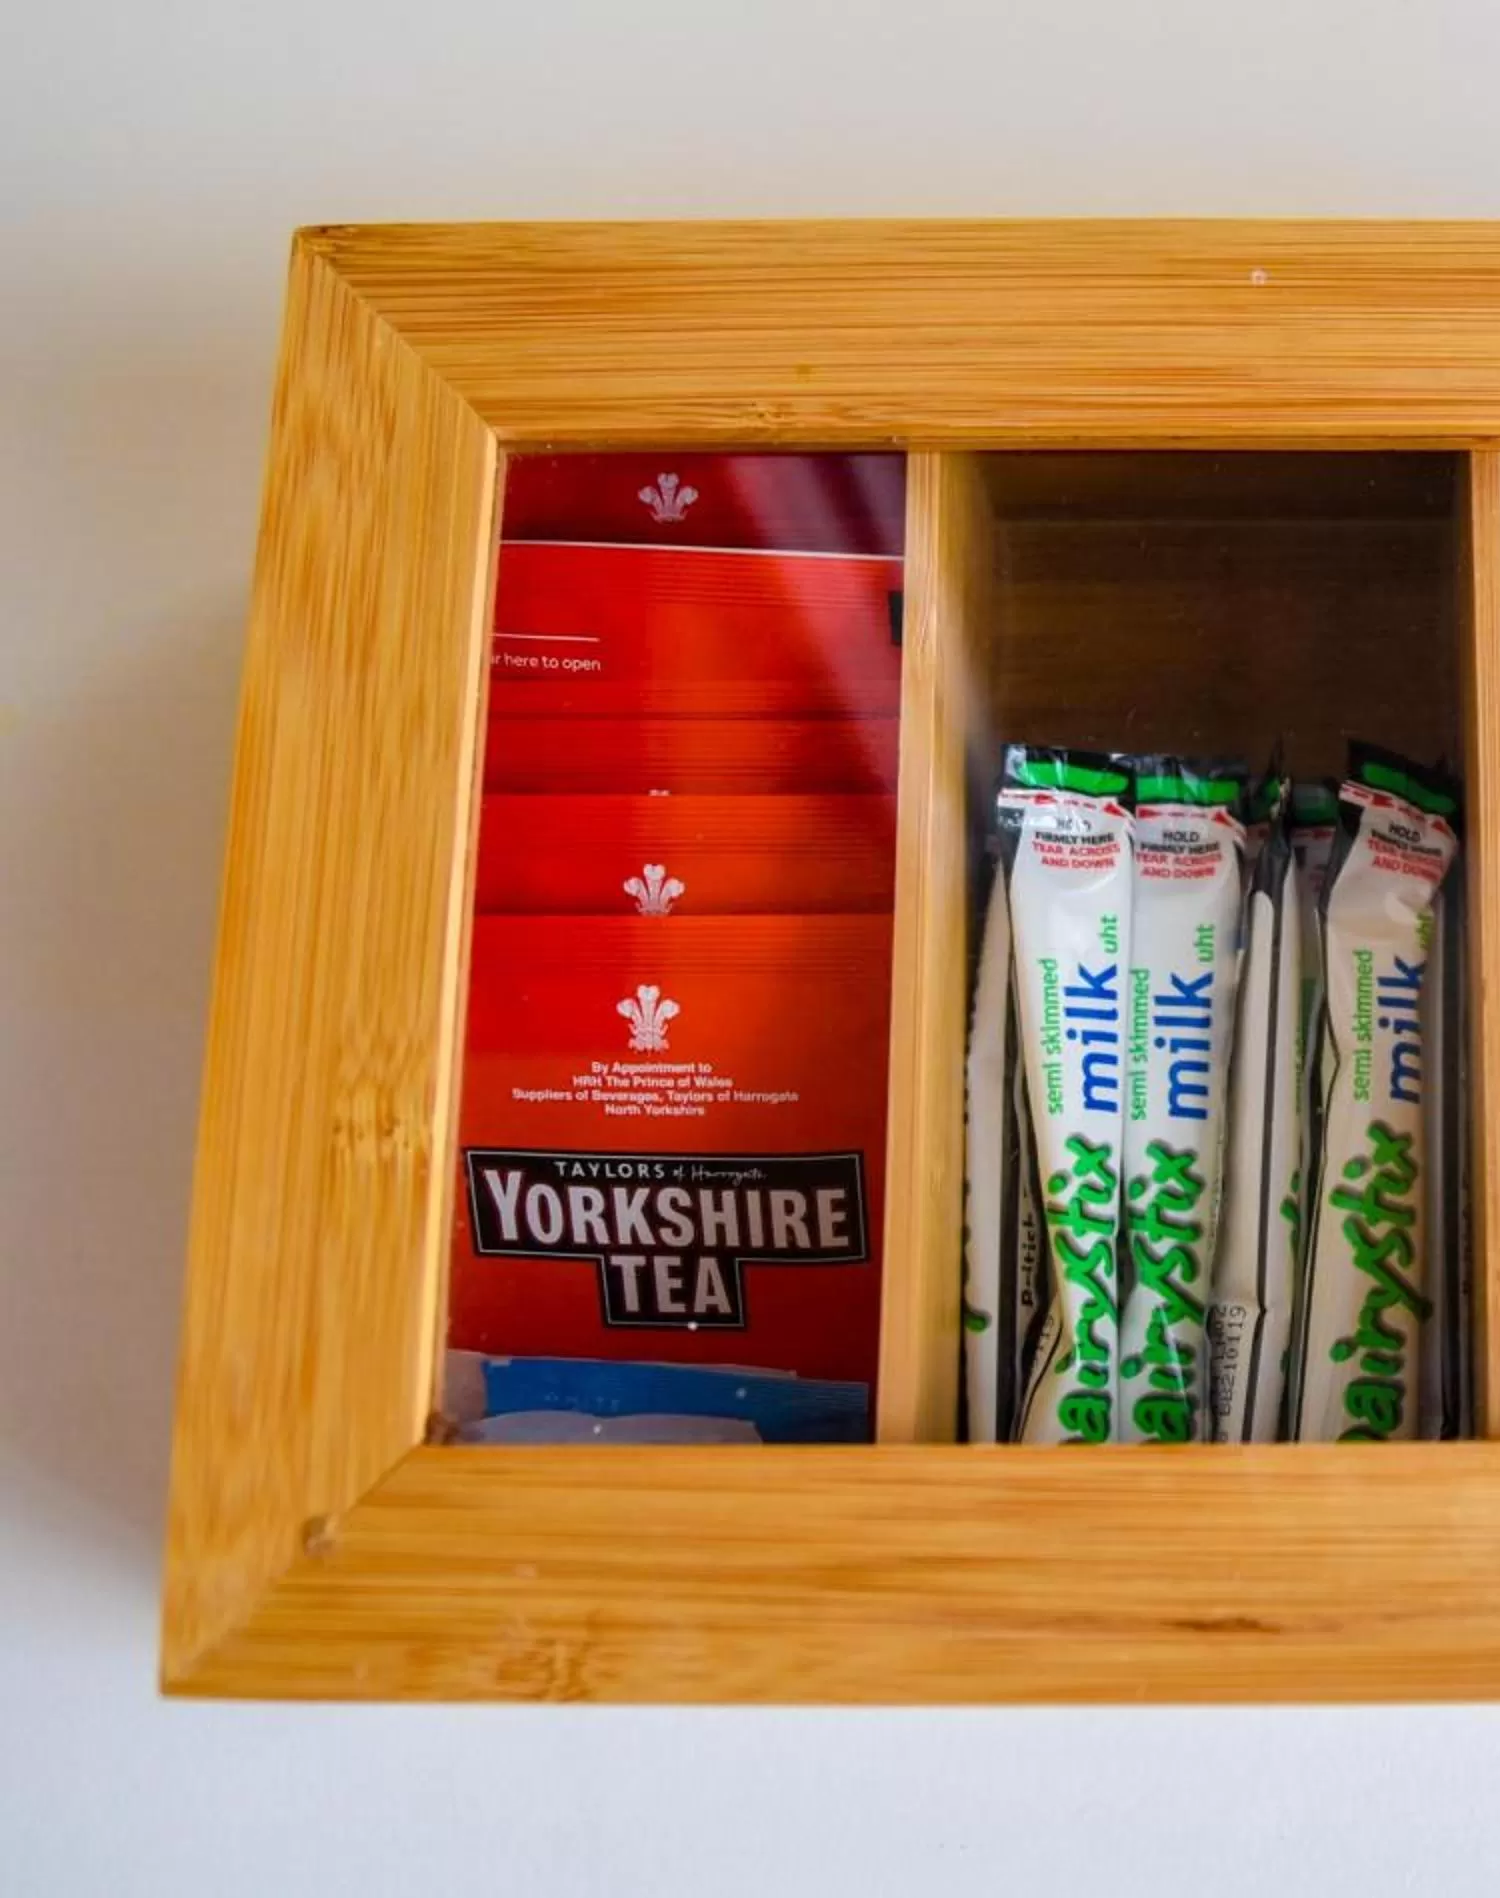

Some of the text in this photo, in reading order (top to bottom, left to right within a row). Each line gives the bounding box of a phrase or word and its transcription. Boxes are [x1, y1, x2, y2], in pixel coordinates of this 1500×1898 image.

[503, 652, 539, 667] here
[541, 655, 559, 669] to
[562, 658, 601, 672] open
[1081, 831, 1115, 844] HERE
[1162, 830, 1200, 843] HOLD
[1388, 821, 1421, 842] HOLD
[1032, 841, 1121, 856] TEAR ACROSS
[1041, 855, 1115, 869] AND DOWN
[1135, 853, 1168, 865] TEAR
[1373, 855, 1401, 871] AND
[1140, 866, 1170, 878] AND
[1064, 914, 1119, 1114] milk uht
[1153, 923, 1216, 1120] milk uht
[1350, 949, 1374, 1102] semi skimmed
[1376, 955, 1426, 1105] milk
[1037, 958, 1064, 1115] semi skimmed
[1127, 968, 1151, 1121] semi skimmed
[591, 1061, 712, 1075] By Appointment to
[573, 1075, 733, 1088] HRH The Prince of Wales
[511, 1088, 573, 1102] Suppliers
[575, 1089, 589, 1101] of
[667, 1089, 714, 1103] Taylors
[717, 1089, 730, 1102] of
[733, 1089, 799, 1104] Harrogate
[604, 1104, 705, 1116] North Yorkshire
[554, 1161, 666, 1178] TAYLORS
[673, 1164, 685, 1178] of
[484, 1168, 850, 1249] YORKSHIRE
[611, 1256, 732, 1314] TEA
[1045, 1132, 1122, 1442] airystix
[1119, 1138, 1207, 1442] airystix
[1328, 1118, 1434, 1442] airystix
